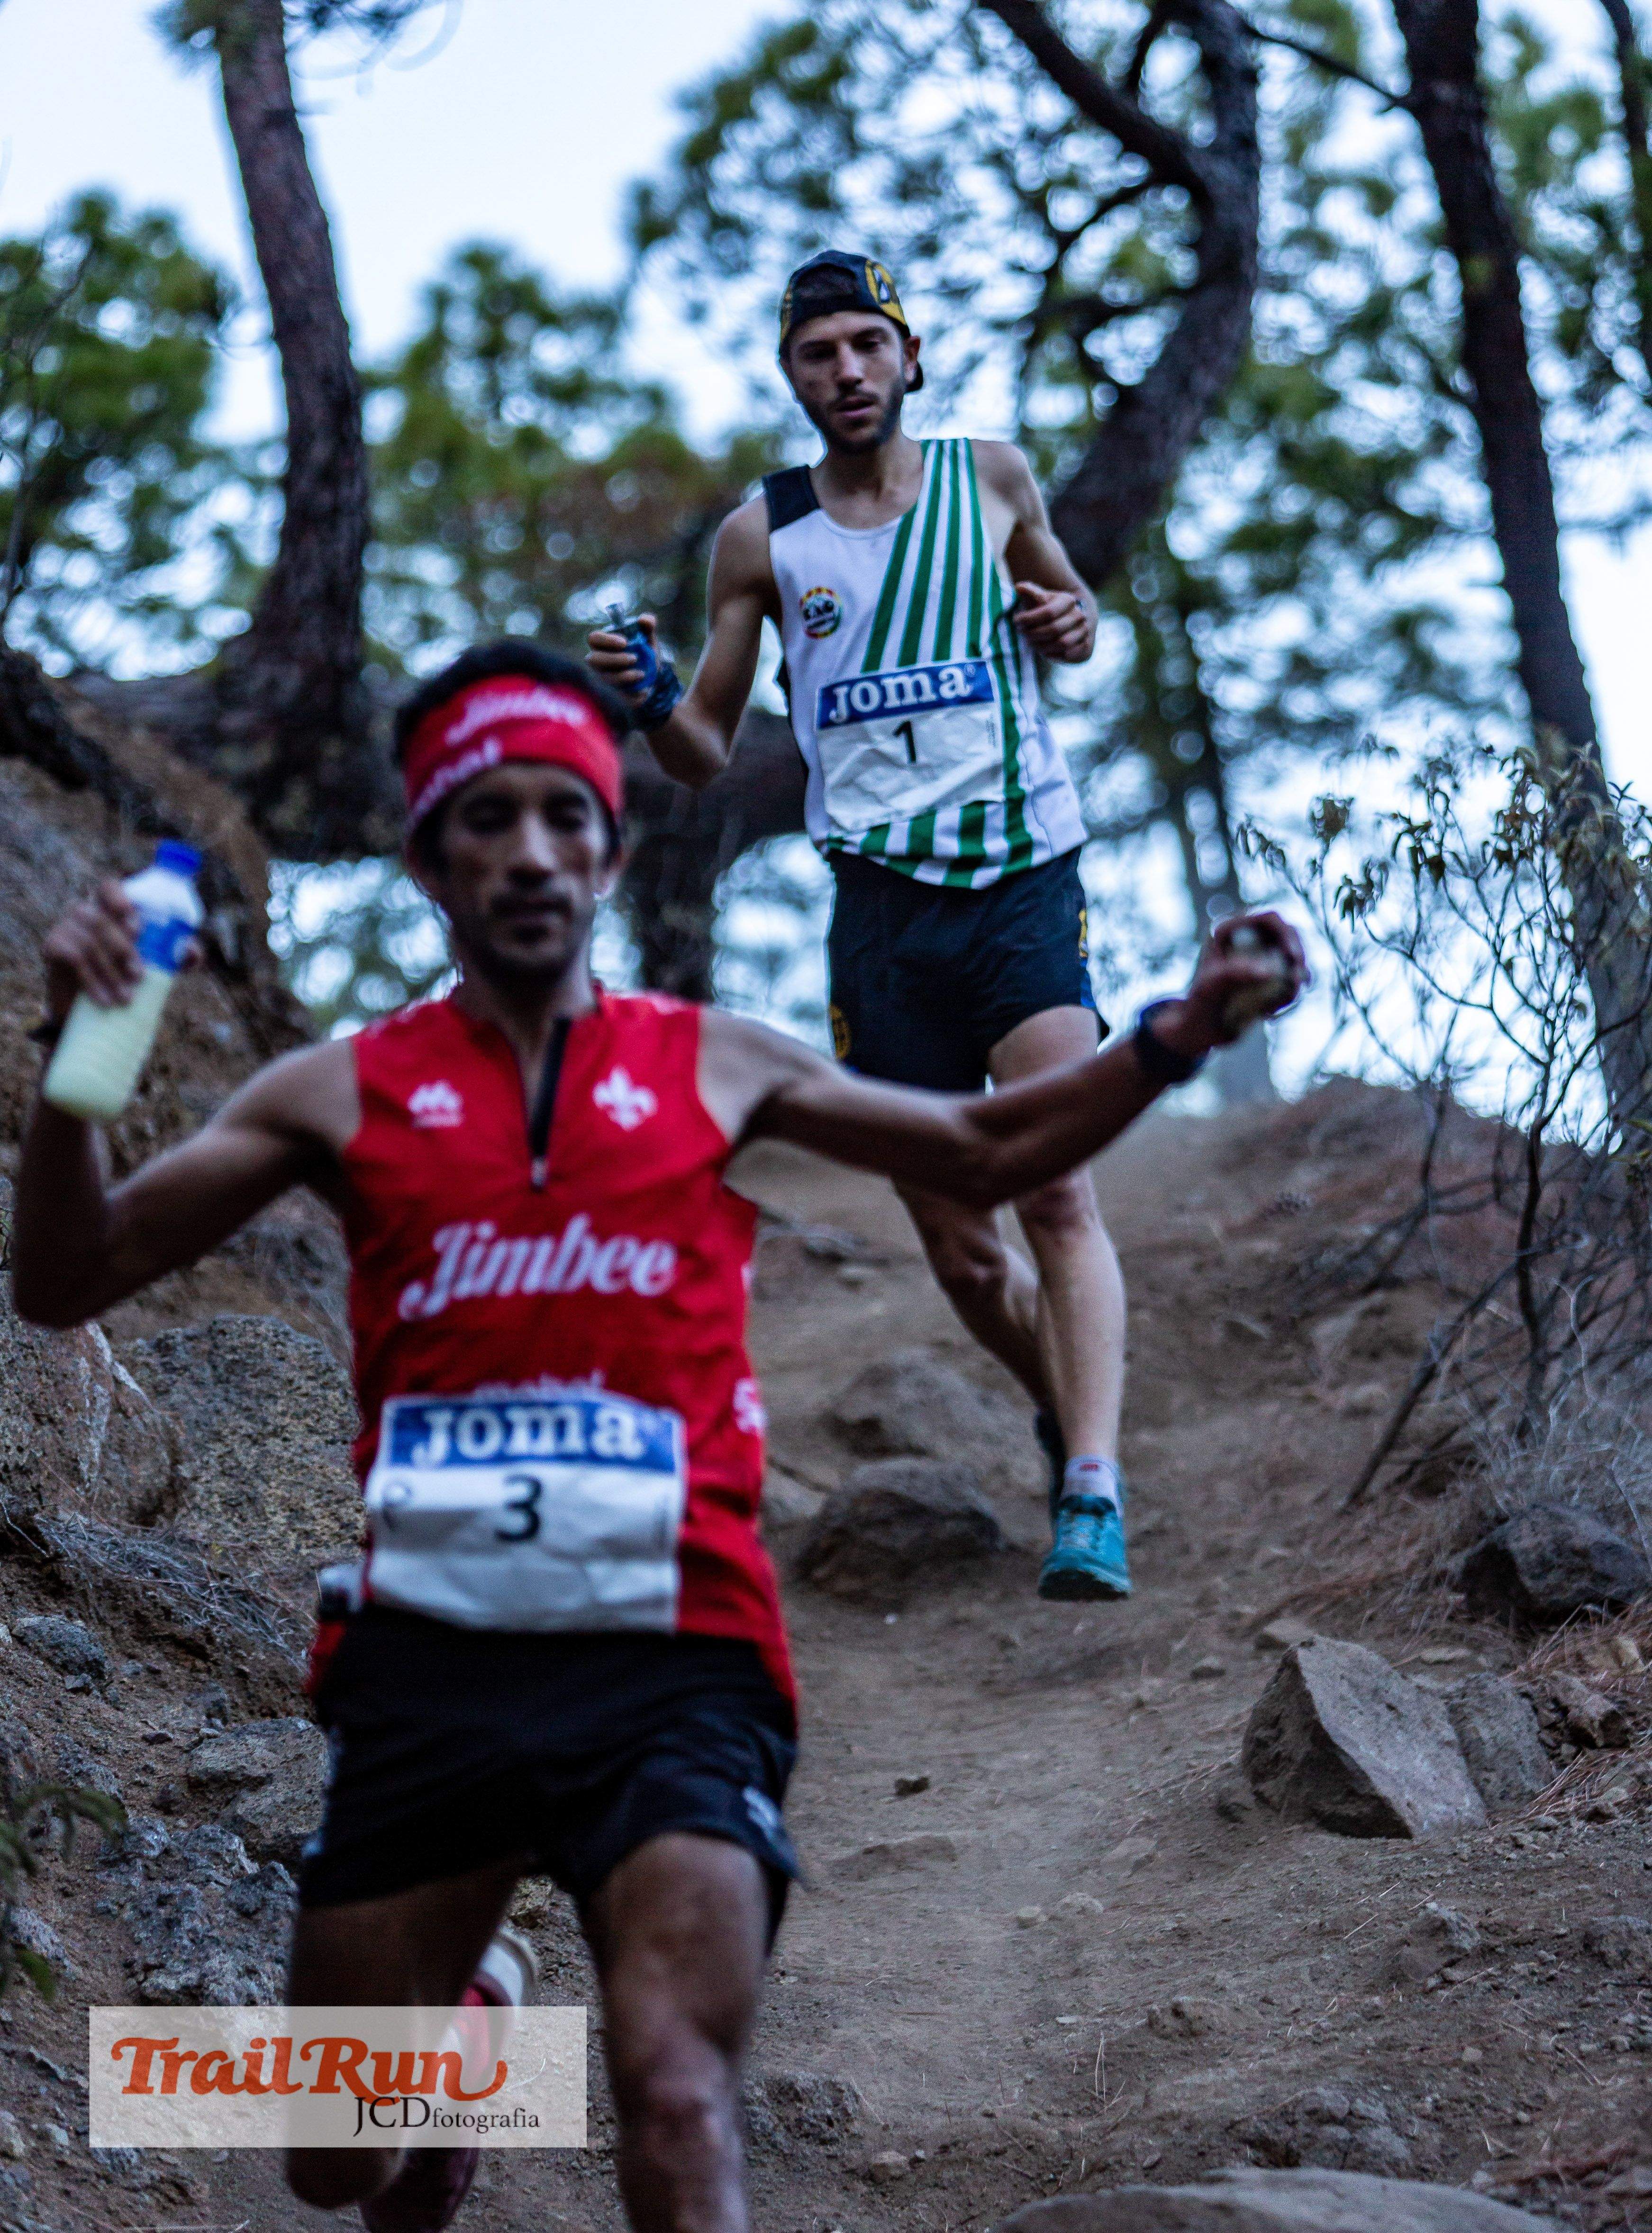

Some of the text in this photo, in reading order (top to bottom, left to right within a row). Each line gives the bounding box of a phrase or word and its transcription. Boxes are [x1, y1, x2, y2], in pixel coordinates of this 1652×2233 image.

[892, 720, 917, 764] 1
[398, 1213, 678, 1322] Jimbee
[495, 1474, 542, 1543] 3
